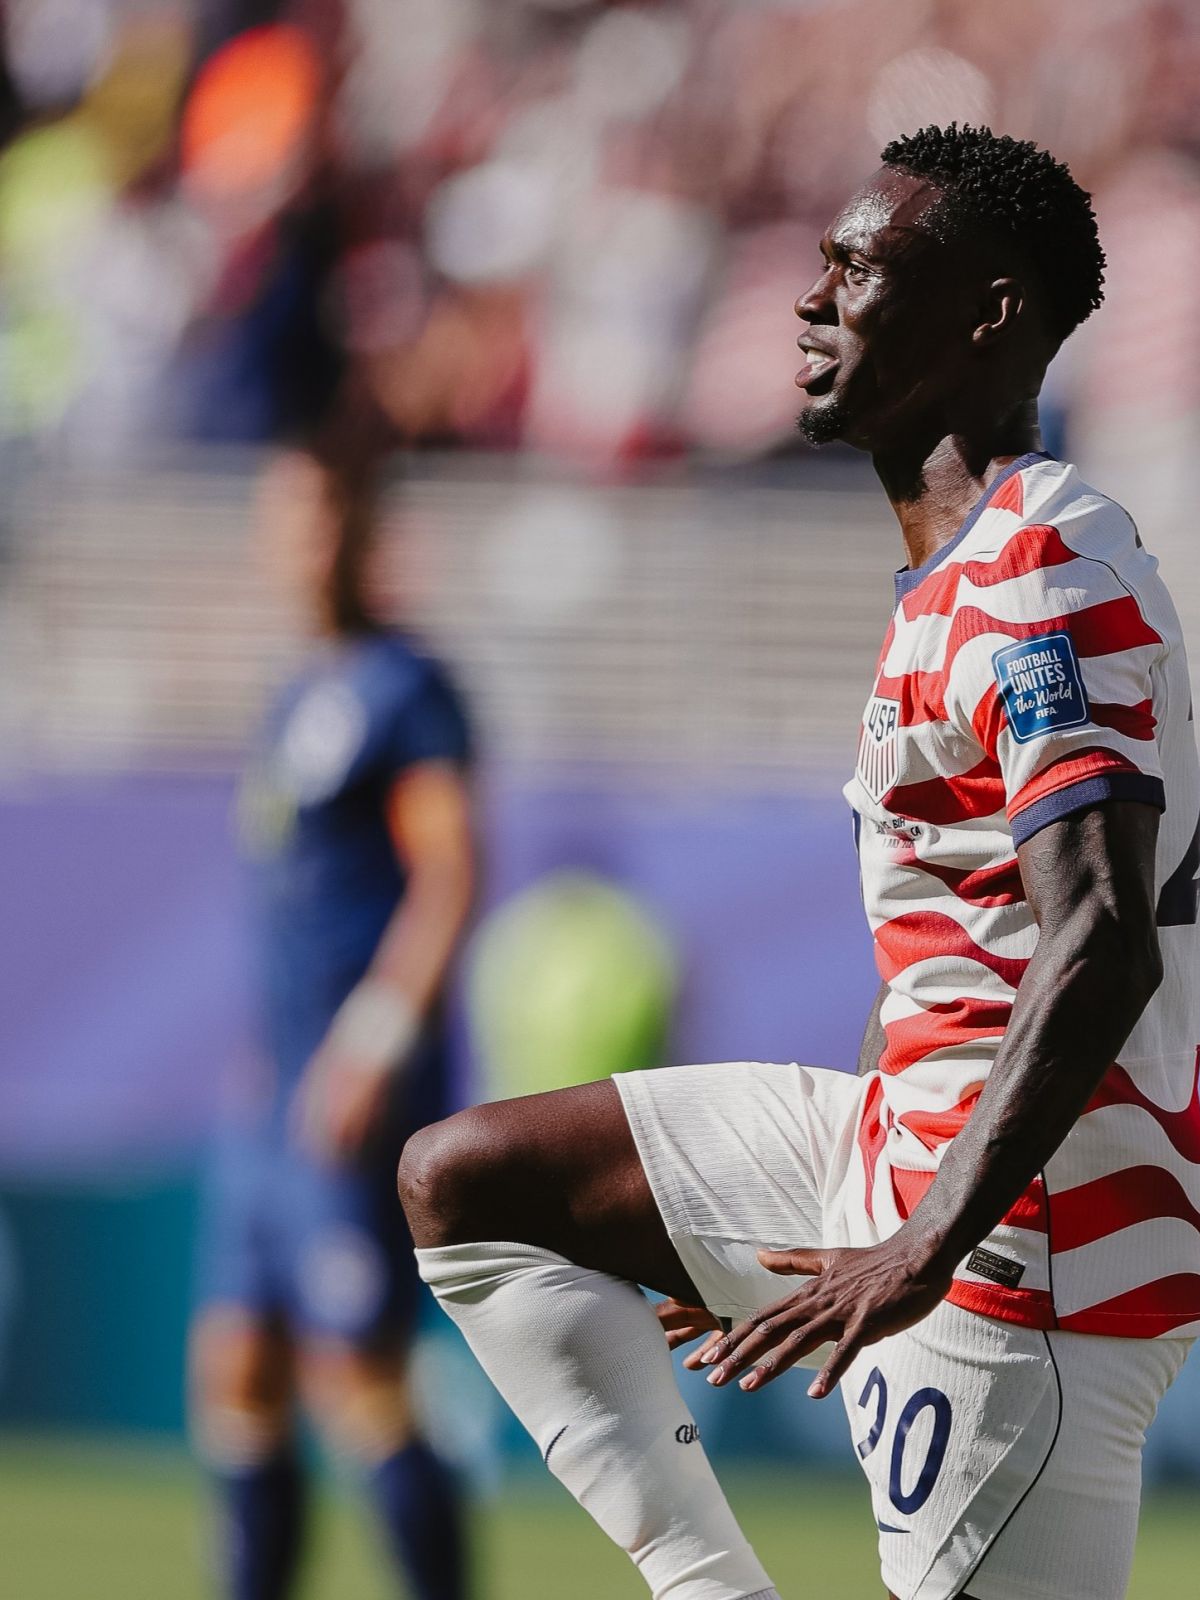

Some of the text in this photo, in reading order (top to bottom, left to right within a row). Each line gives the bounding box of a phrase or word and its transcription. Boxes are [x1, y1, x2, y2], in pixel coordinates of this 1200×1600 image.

[1006, 649, 1062, 677] FOOTBALL
[1009, 663, 1066, 695] UNITES
[1014, 682, 1073, 714] the World
[1035, 706, 1057, 720] FIFA
[868, 703, 897, 742] USA
